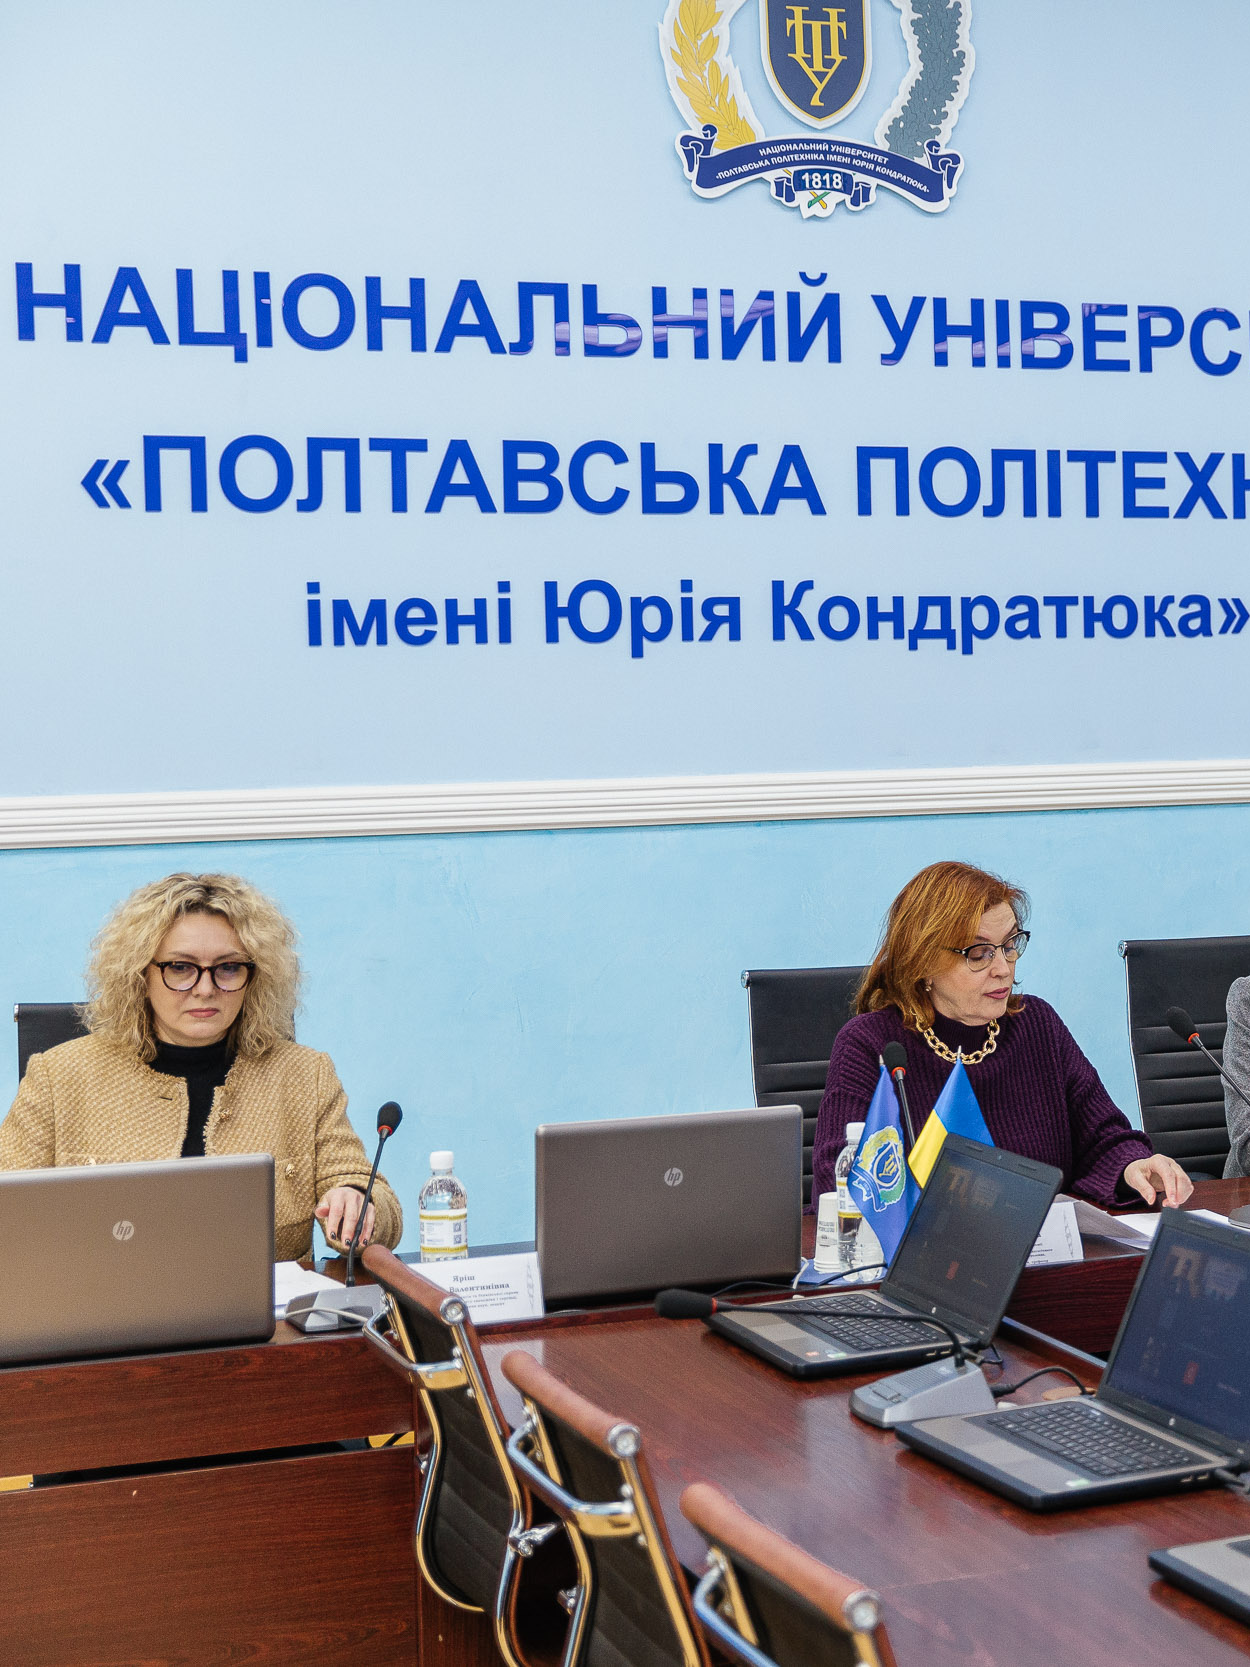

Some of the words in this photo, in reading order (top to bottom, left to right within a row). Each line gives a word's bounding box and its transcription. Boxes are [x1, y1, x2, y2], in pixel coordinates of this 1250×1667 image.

[759, 143, 829, 156] НАЦІОНАЛЬНИЙ
[830, 144, 889, 164] УНІВЕРСИТЕТ
[771, 153, 825, 165] ПОЛІТЕХНІКА
[826, 153, 850, 164] ІМЕНІ
[852, 158, 875, 170] ЮРІЯ
[801, 172, 842, 188] 1818
[15, 262, 842, 364] НАЦІОНАЛЬНИЙ
[80, 434, 827, 516] «ПОЛТАВСЬКА
[306, 580, 512, 647] імені
[543, 579, 742, 659] Юрія
[771, 579, 1250, 656] Кондратюка»
[664, 1167, 683, 1187] hp
[113, 1220, 134, 1240] hp
[449, 1283, 510, 1293] Валентинівна
[452, 1275, 475, 1283] Яріш
